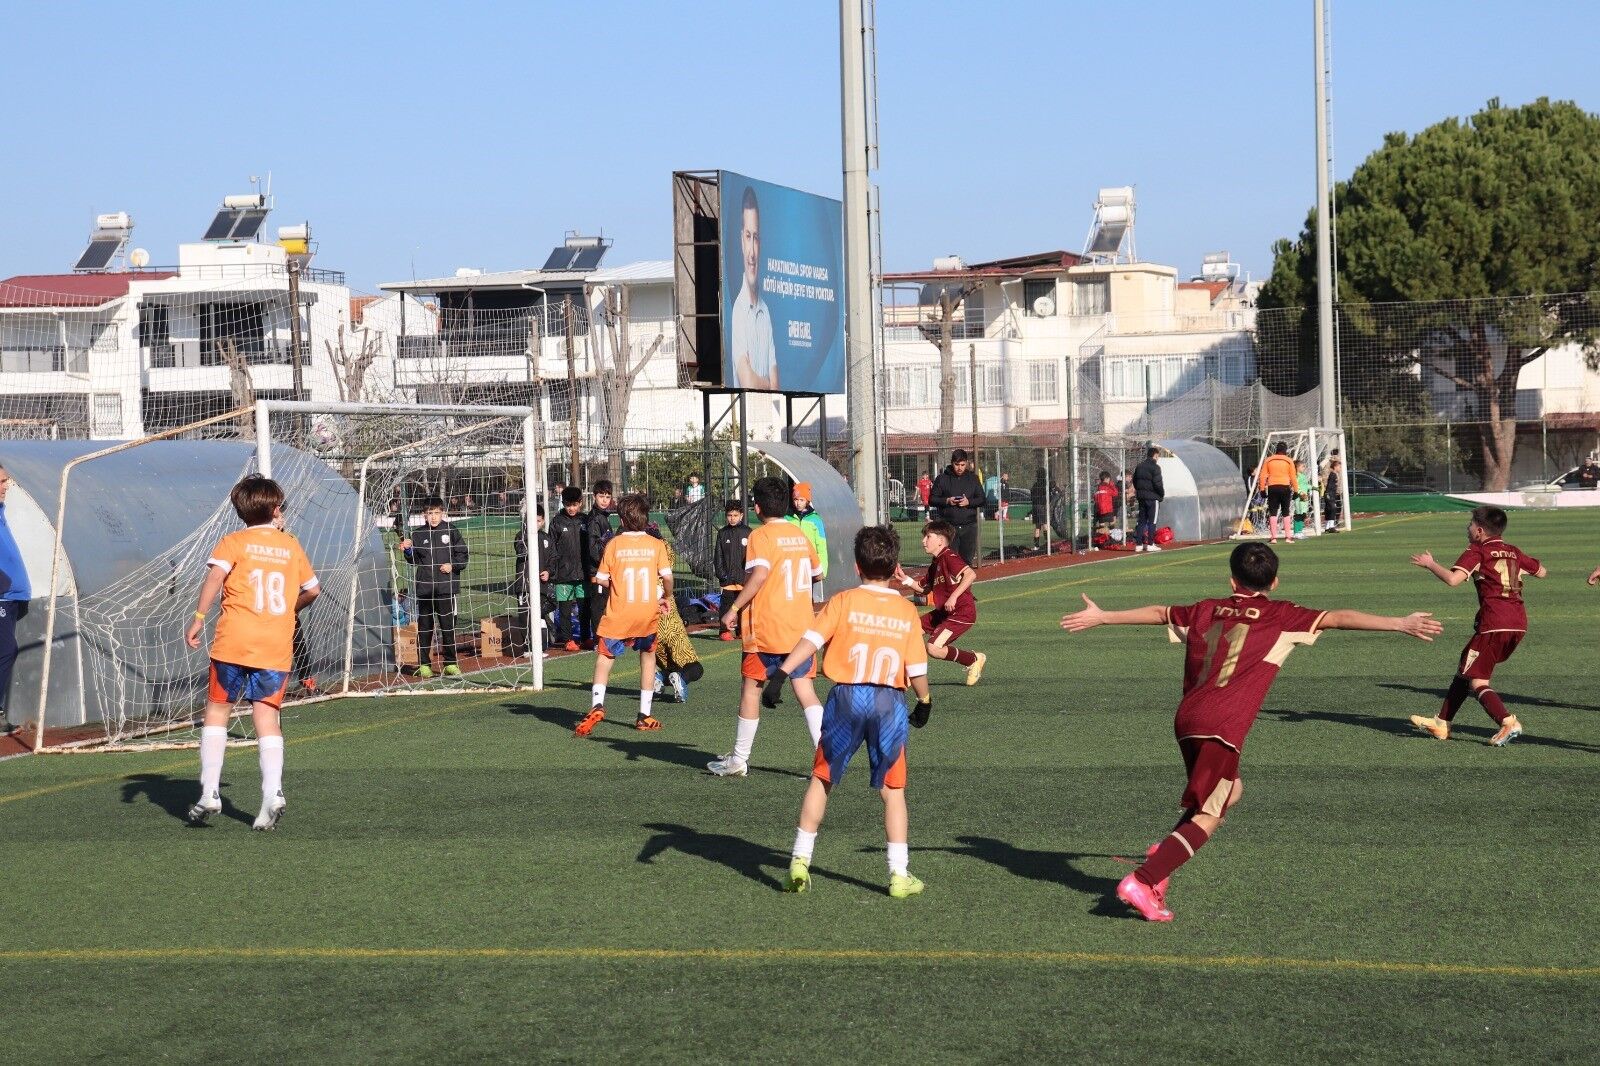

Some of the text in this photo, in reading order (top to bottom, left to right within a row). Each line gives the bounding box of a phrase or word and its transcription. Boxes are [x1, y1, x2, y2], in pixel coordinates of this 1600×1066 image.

[800, 264, 813, 278] SPOR
[806, 284, 814, 299] YER
[249, 568, 287, 616] 18
[622, 567, 650, 603] 11
[781, 557, 812, 601] 14
[848, 611, 912, 633] ATAKUM
[848, 643, 900, 687] 10
[1198, 620, 1250, 688] 11
